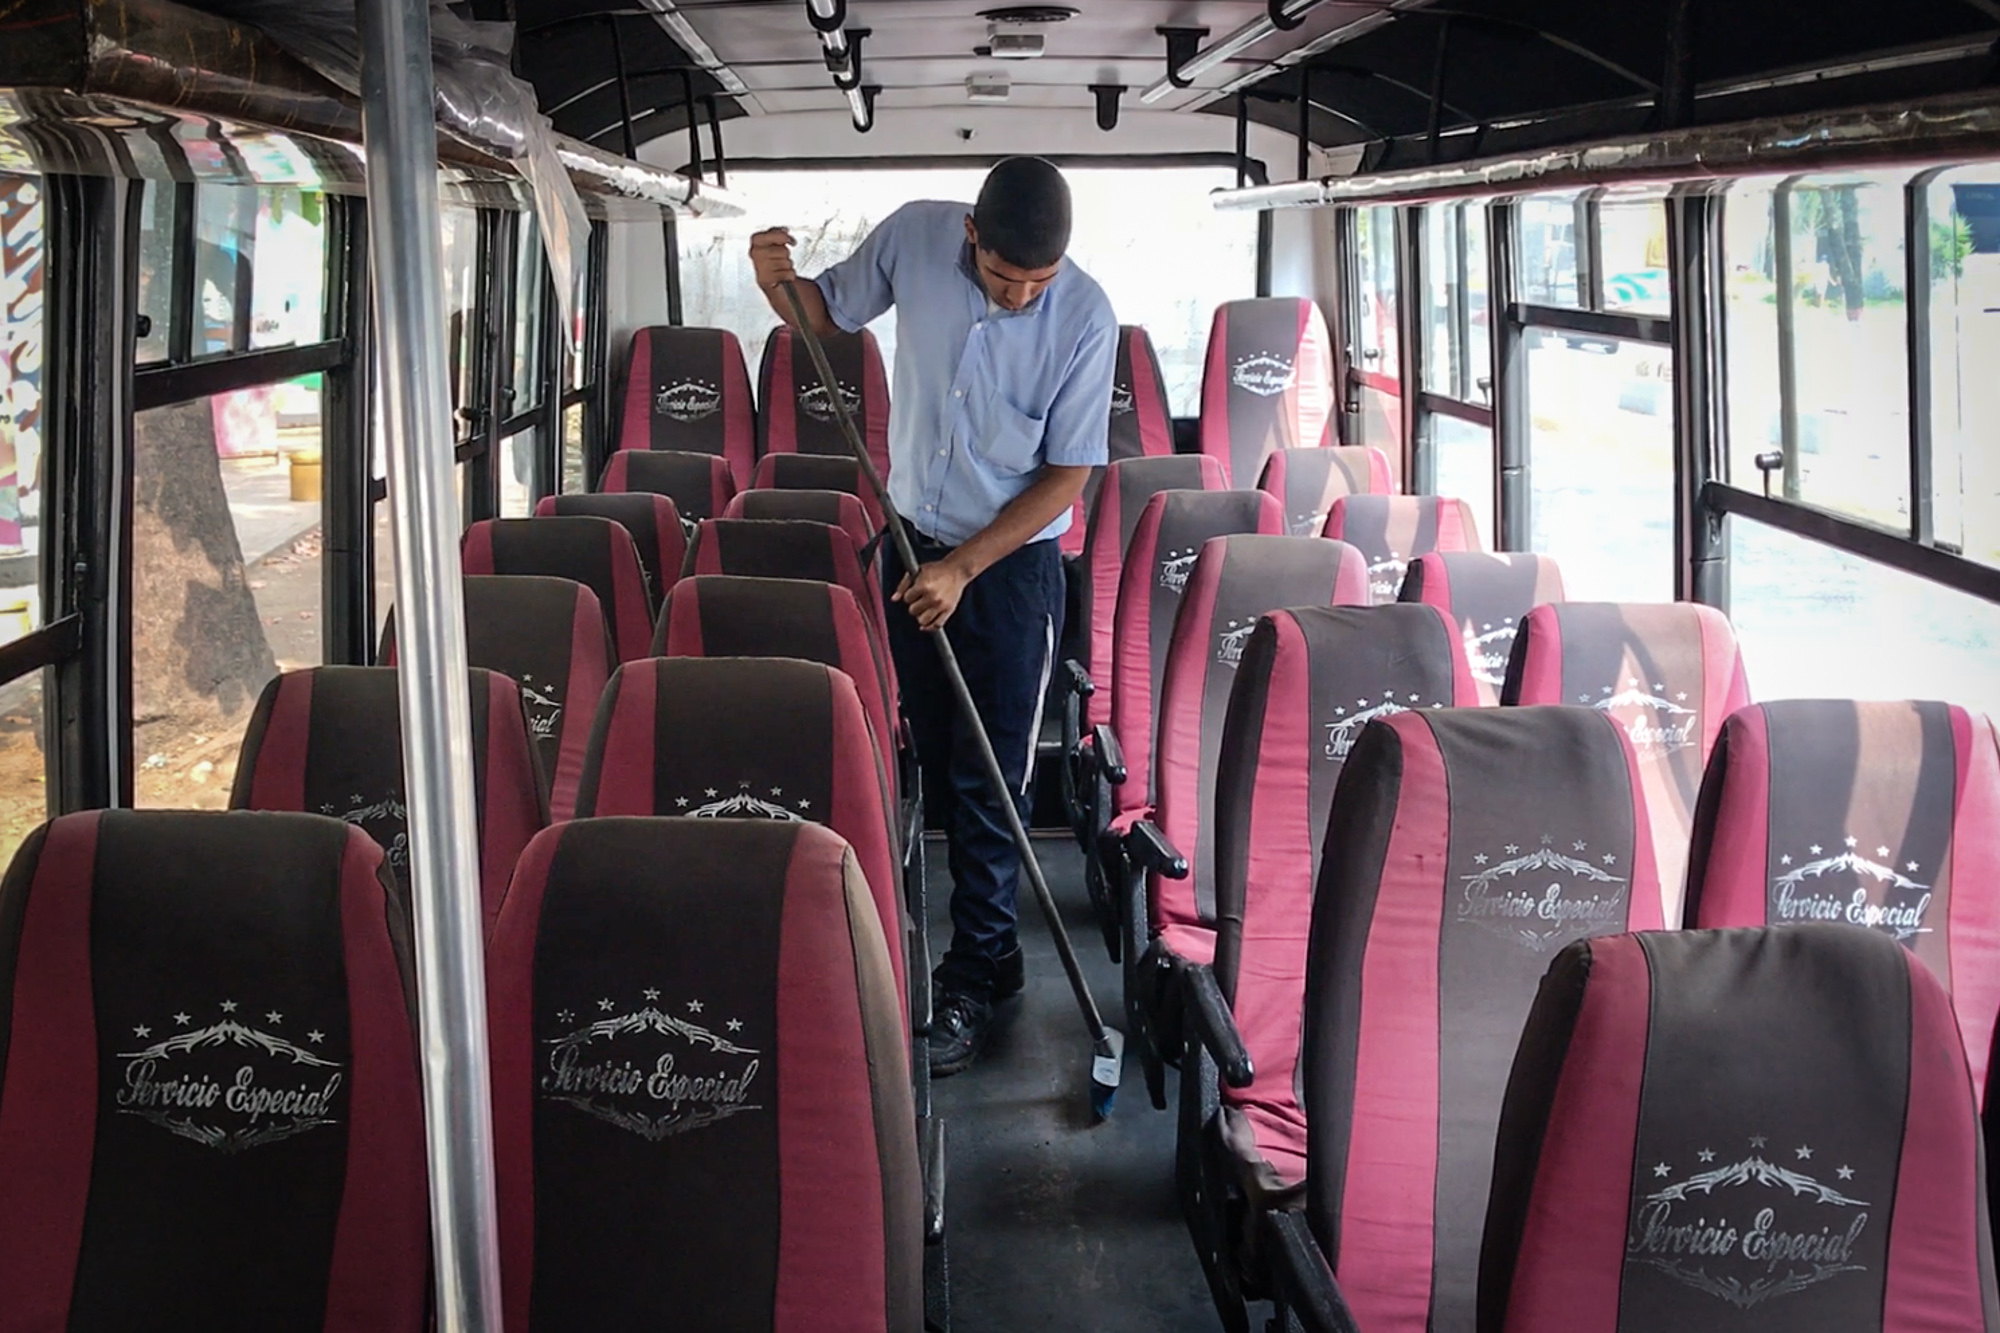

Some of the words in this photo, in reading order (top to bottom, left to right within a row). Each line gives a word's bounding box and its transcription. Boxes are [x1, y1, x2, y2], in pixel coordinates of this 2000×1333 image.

[1456, 879, 1535, 917] Servicio
[1537, 882, 1626, 928] Especial
[1772, 880, 1843, 919] Servicio
[1845, 887, 1932, 928] Especial
[116, 1058, 222, 1107] Servicio
[225, 1064, 343, 1124] Especial
[541, 1043, 643, 1095] Servicio
[646, 1053, 760, 1111] Especial
[1626, 1200, 1739, 1256] Servicio
[1741, 1207, 1868, 1273] Especial
